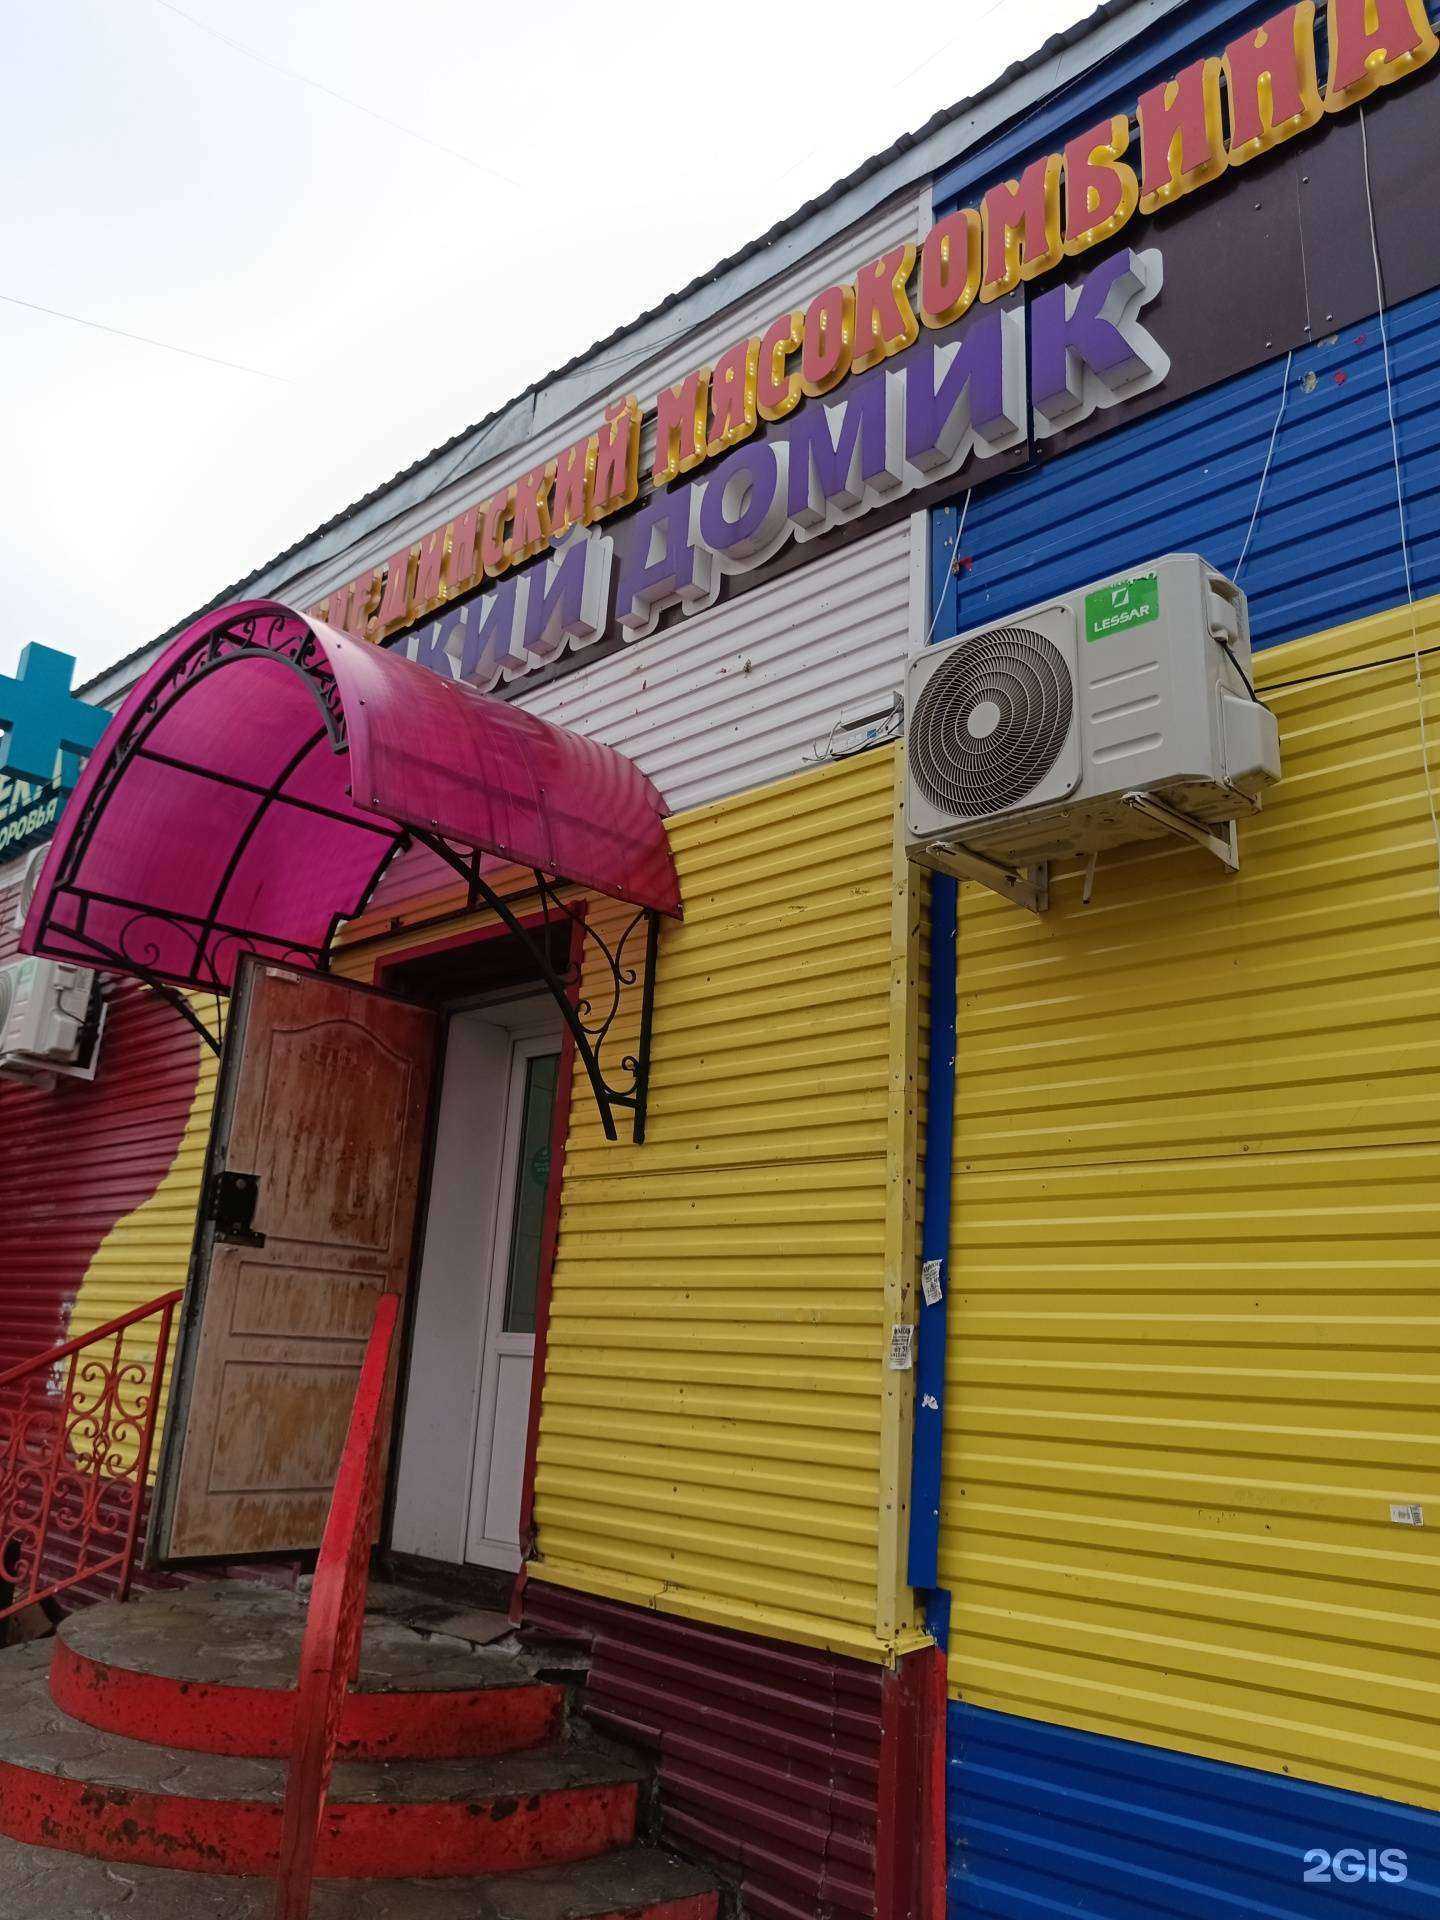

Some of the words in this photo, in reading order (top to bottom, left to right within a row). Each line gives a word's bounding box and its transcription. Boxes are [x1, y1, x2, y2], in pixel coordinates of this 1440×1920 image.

[388, 521, 614, 693] КИЙ
[614, 247, 1170, 643] ДОМИК
[1094, 605, 1150, 632] LESSAR
